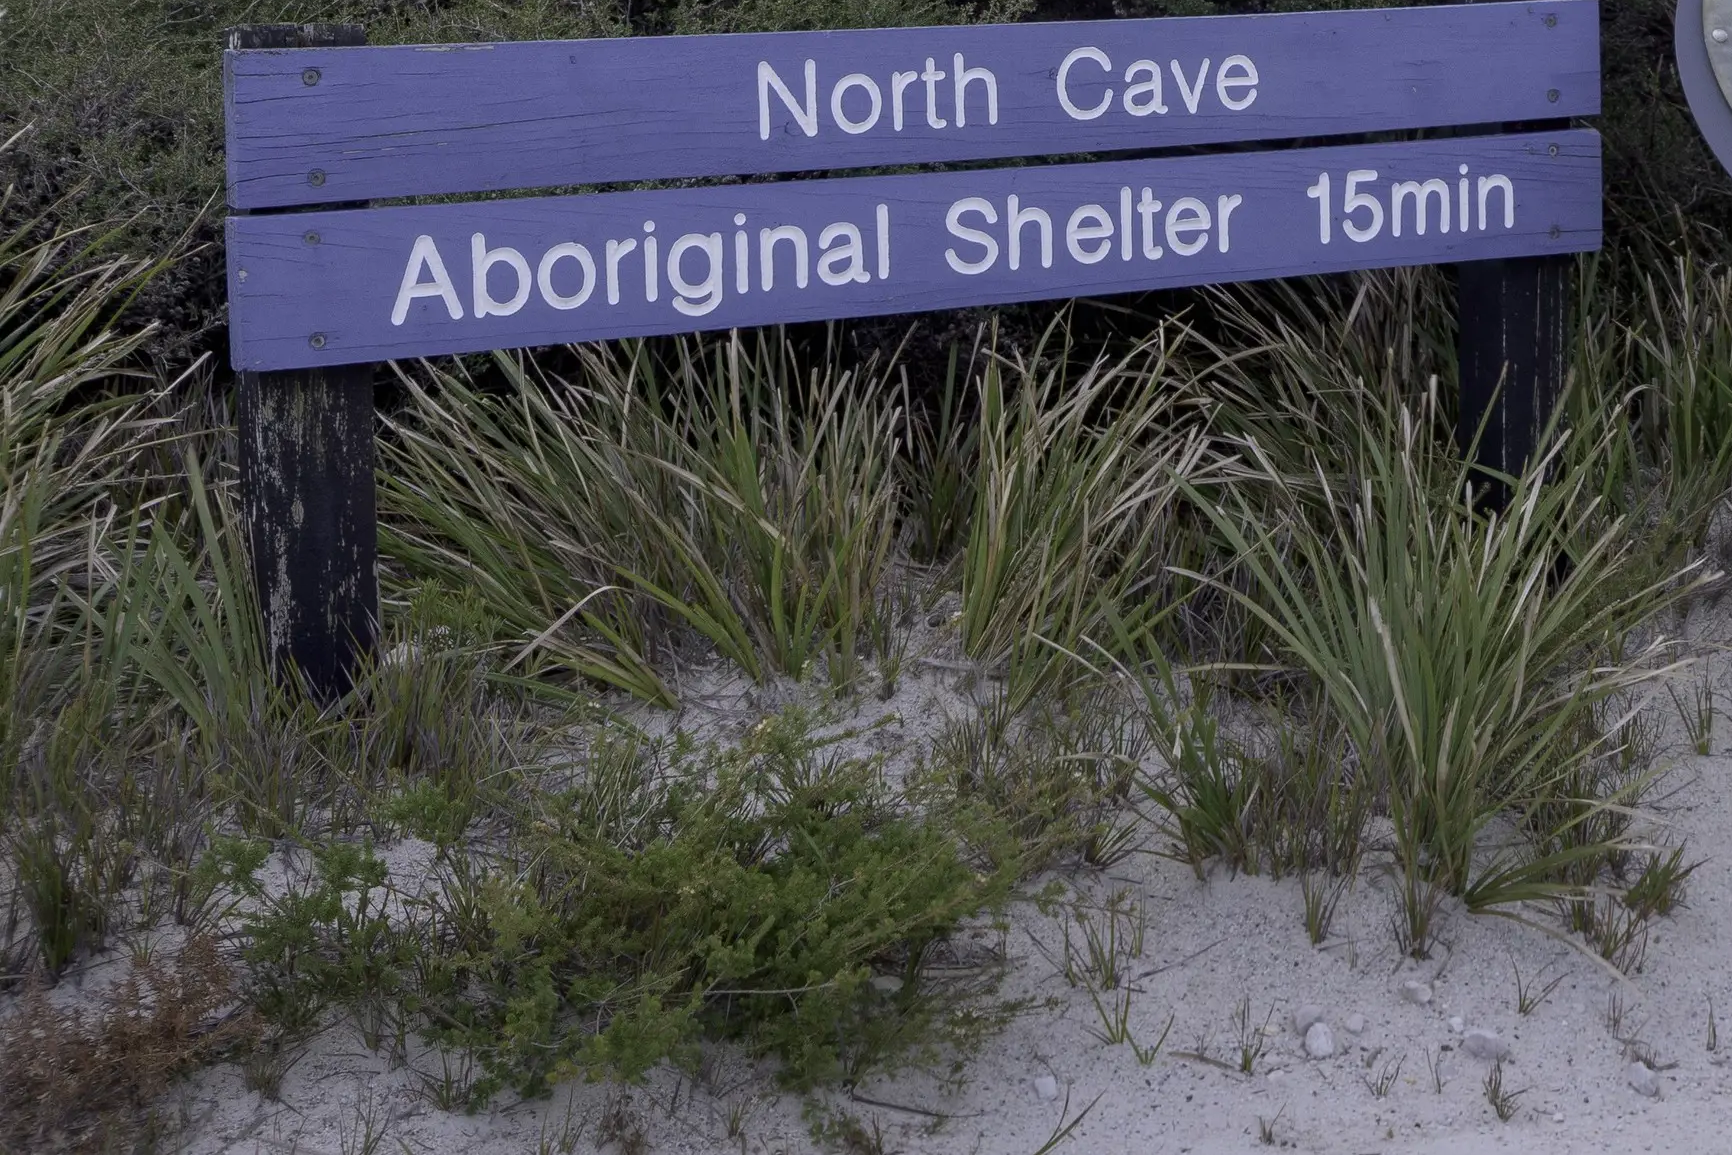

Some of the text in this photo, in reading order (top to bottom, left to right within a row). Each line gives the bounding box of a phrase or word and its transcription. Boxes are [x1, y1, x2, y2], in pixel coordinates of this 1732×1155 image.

[757, 46, 1260, 141] North Cave
[390, 163, 1516, 327] Aboriginal Shelter 15min
